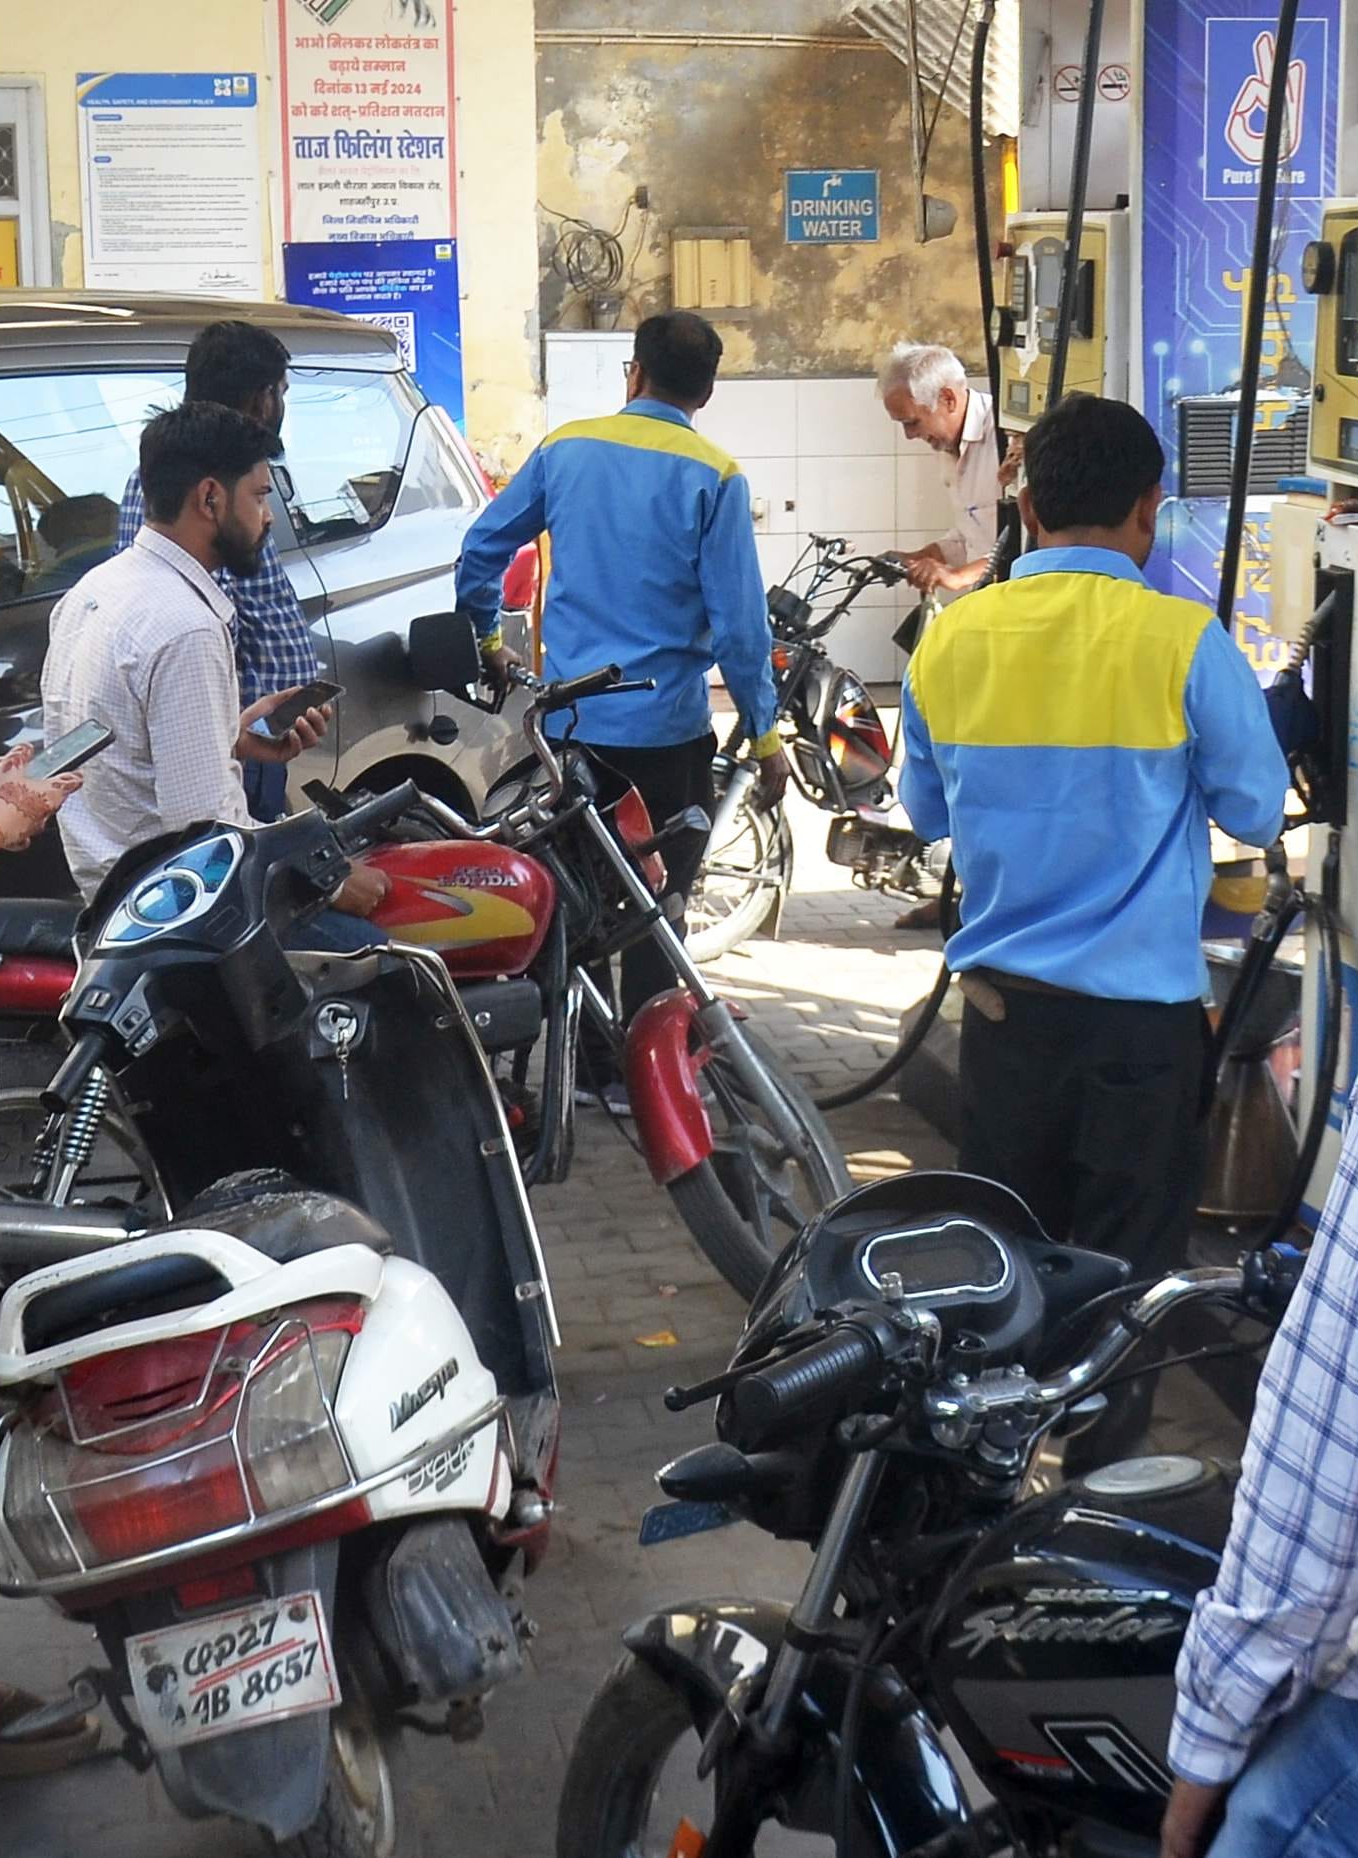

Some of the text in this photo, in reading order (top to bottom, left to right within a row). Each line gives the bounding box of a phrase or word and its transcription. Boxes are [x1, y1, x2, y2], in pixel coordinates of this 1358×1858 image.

[295, 33, 439, 50] आओ मिलकर लोकतंत्र का
[362, 60, 406, 72] सम्मान
[314, 78, 421, 95] दिनांक 13 मई 2024
[291, 102, 307, 117] को
[403, 105, 445, 117] मतदान
[293, 129, 444, 158] ताज फिलिंग स्टेशन
[1223, 168, 1253, 184] Pure
[791, 199, 873, 216] DRINKING
[802, 220, 862, 237] WATER
[241, 1642, 319, 1707] 8657
